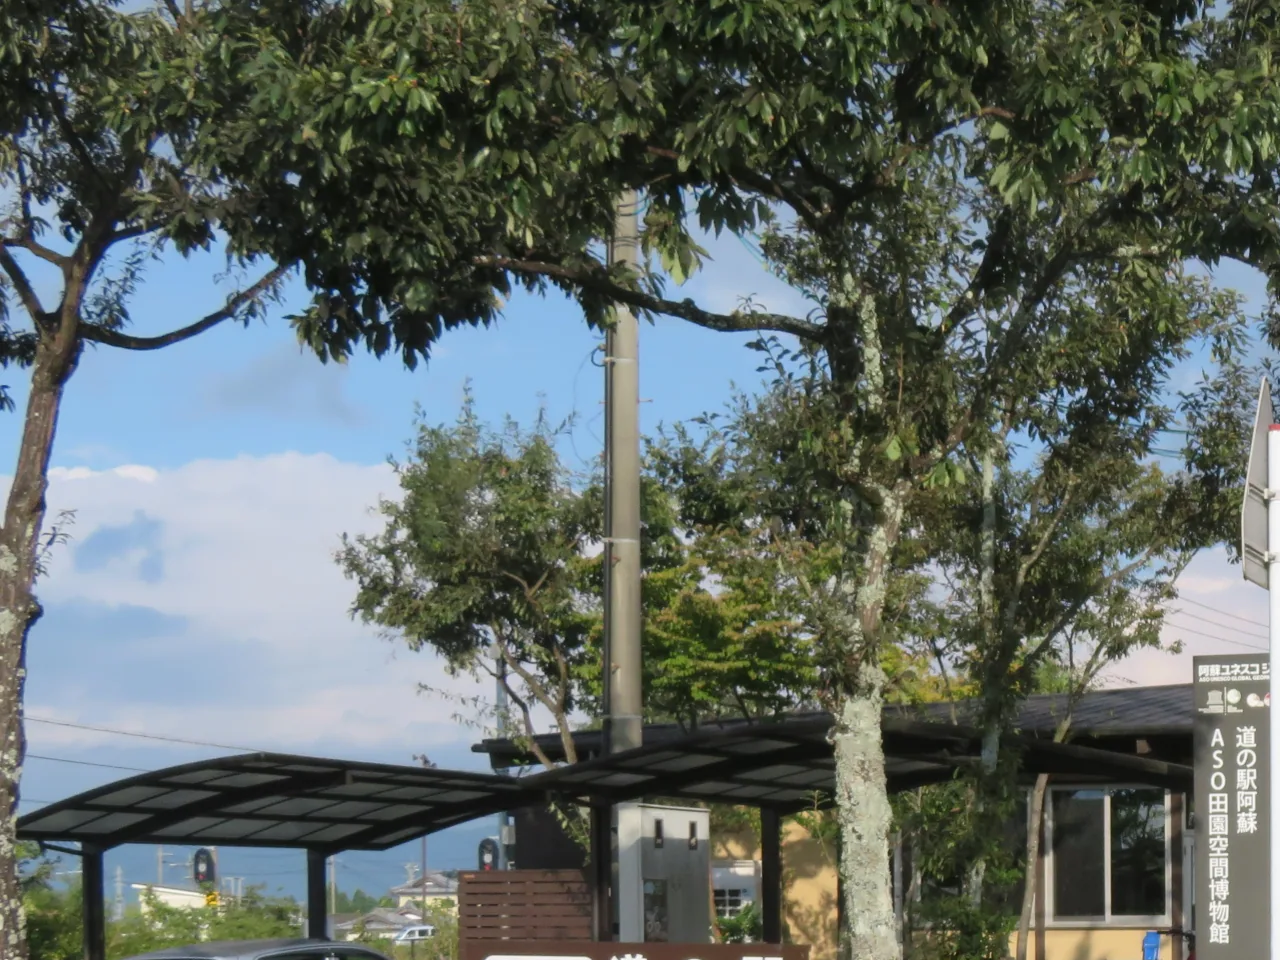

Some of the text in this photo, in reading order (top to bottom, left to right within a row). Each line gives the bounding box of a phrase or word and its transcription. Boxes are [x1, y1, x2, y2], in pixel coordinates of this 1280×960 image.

[1208, 727, 1230, 945] ASO田園空間博物館
[1236, 725, 1258, 835] 道の駅阿蘇
